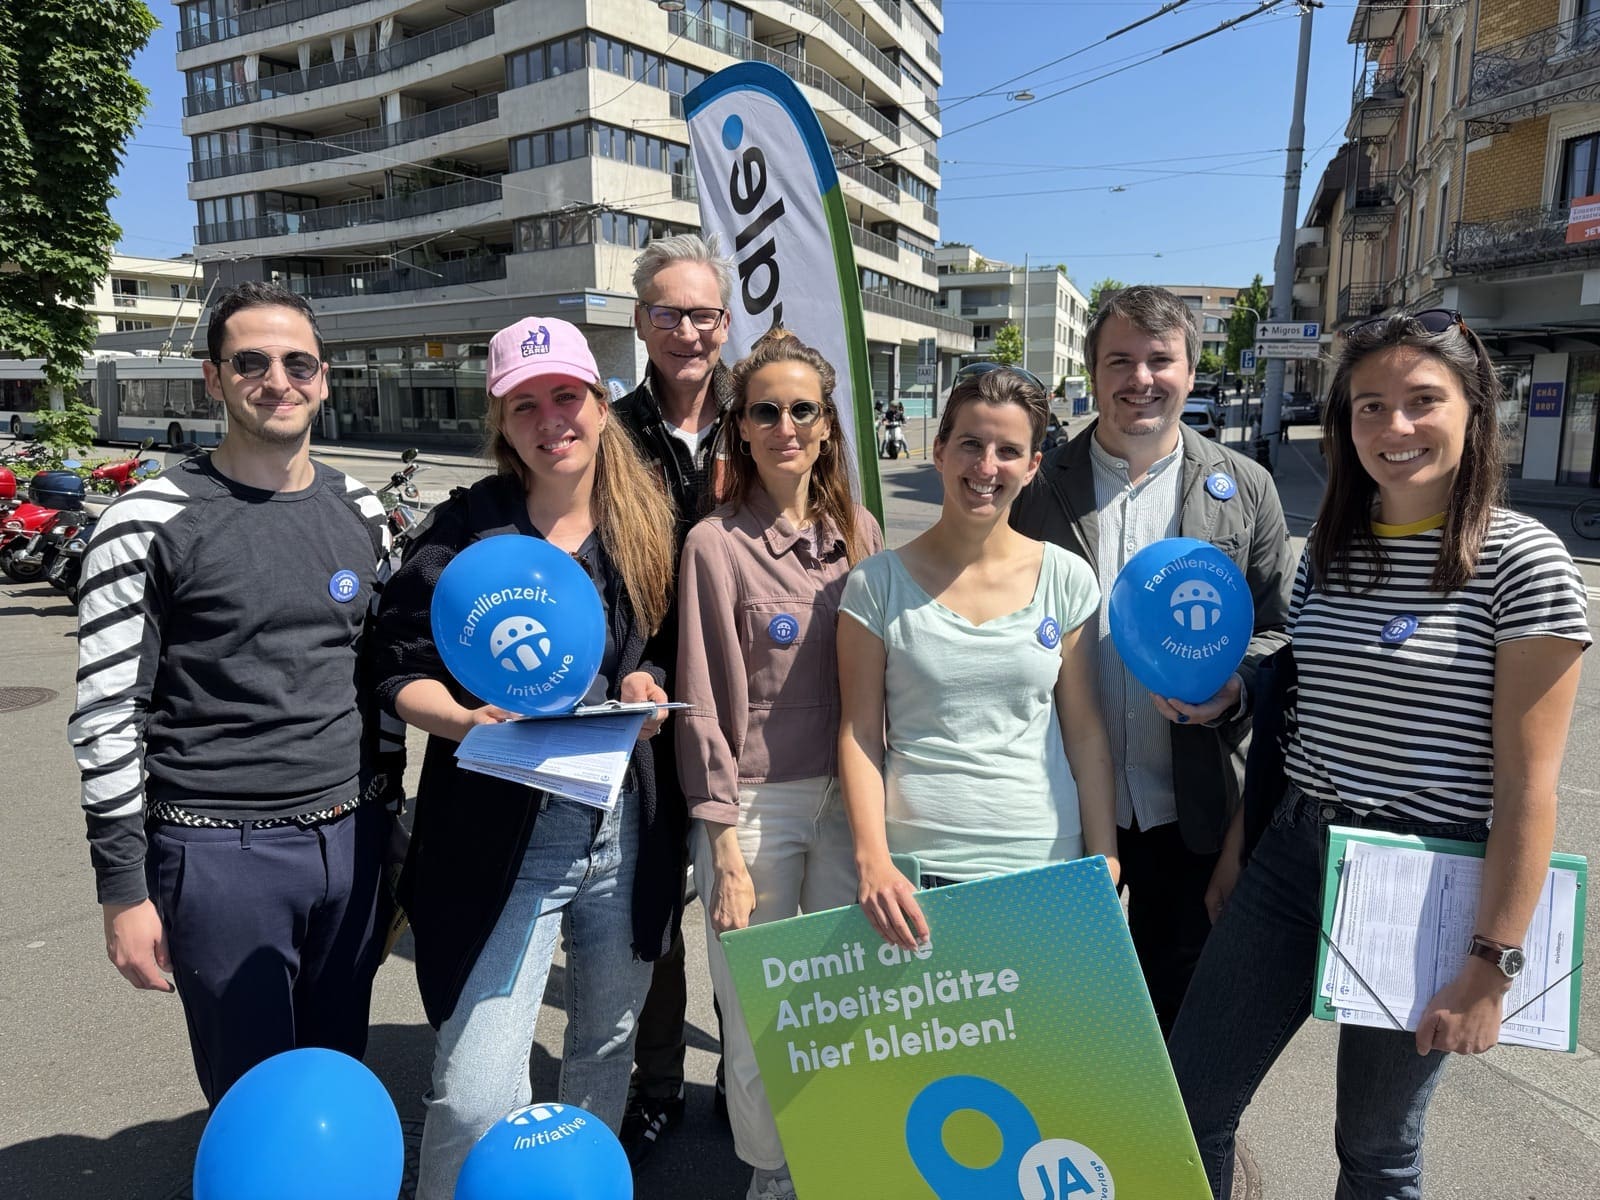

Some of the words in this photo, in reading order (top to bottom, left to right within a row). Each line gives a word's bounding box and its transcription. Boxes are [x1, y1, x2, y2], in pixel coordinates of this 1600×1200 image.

[1271, 326, 1300, 336] Migros
[1144, 558, 1237, 592] Familienzeit-
[459, 586, 557, 647] Familienzeit-
[1161, 635, 1229, 660] Initiative
[506, 654, 574, 697] Initiative
[762, 942, 865, 988] Damit
[776, 968, 1020, 1031] Arbeitsplätze
[787, 1040, 855, 1073] hier
[865, 1008, 1017, 1062] bleiben!
[513, 1116, 587, 1150] Initiative
[1036, 1156, 1095, 1200] JA
